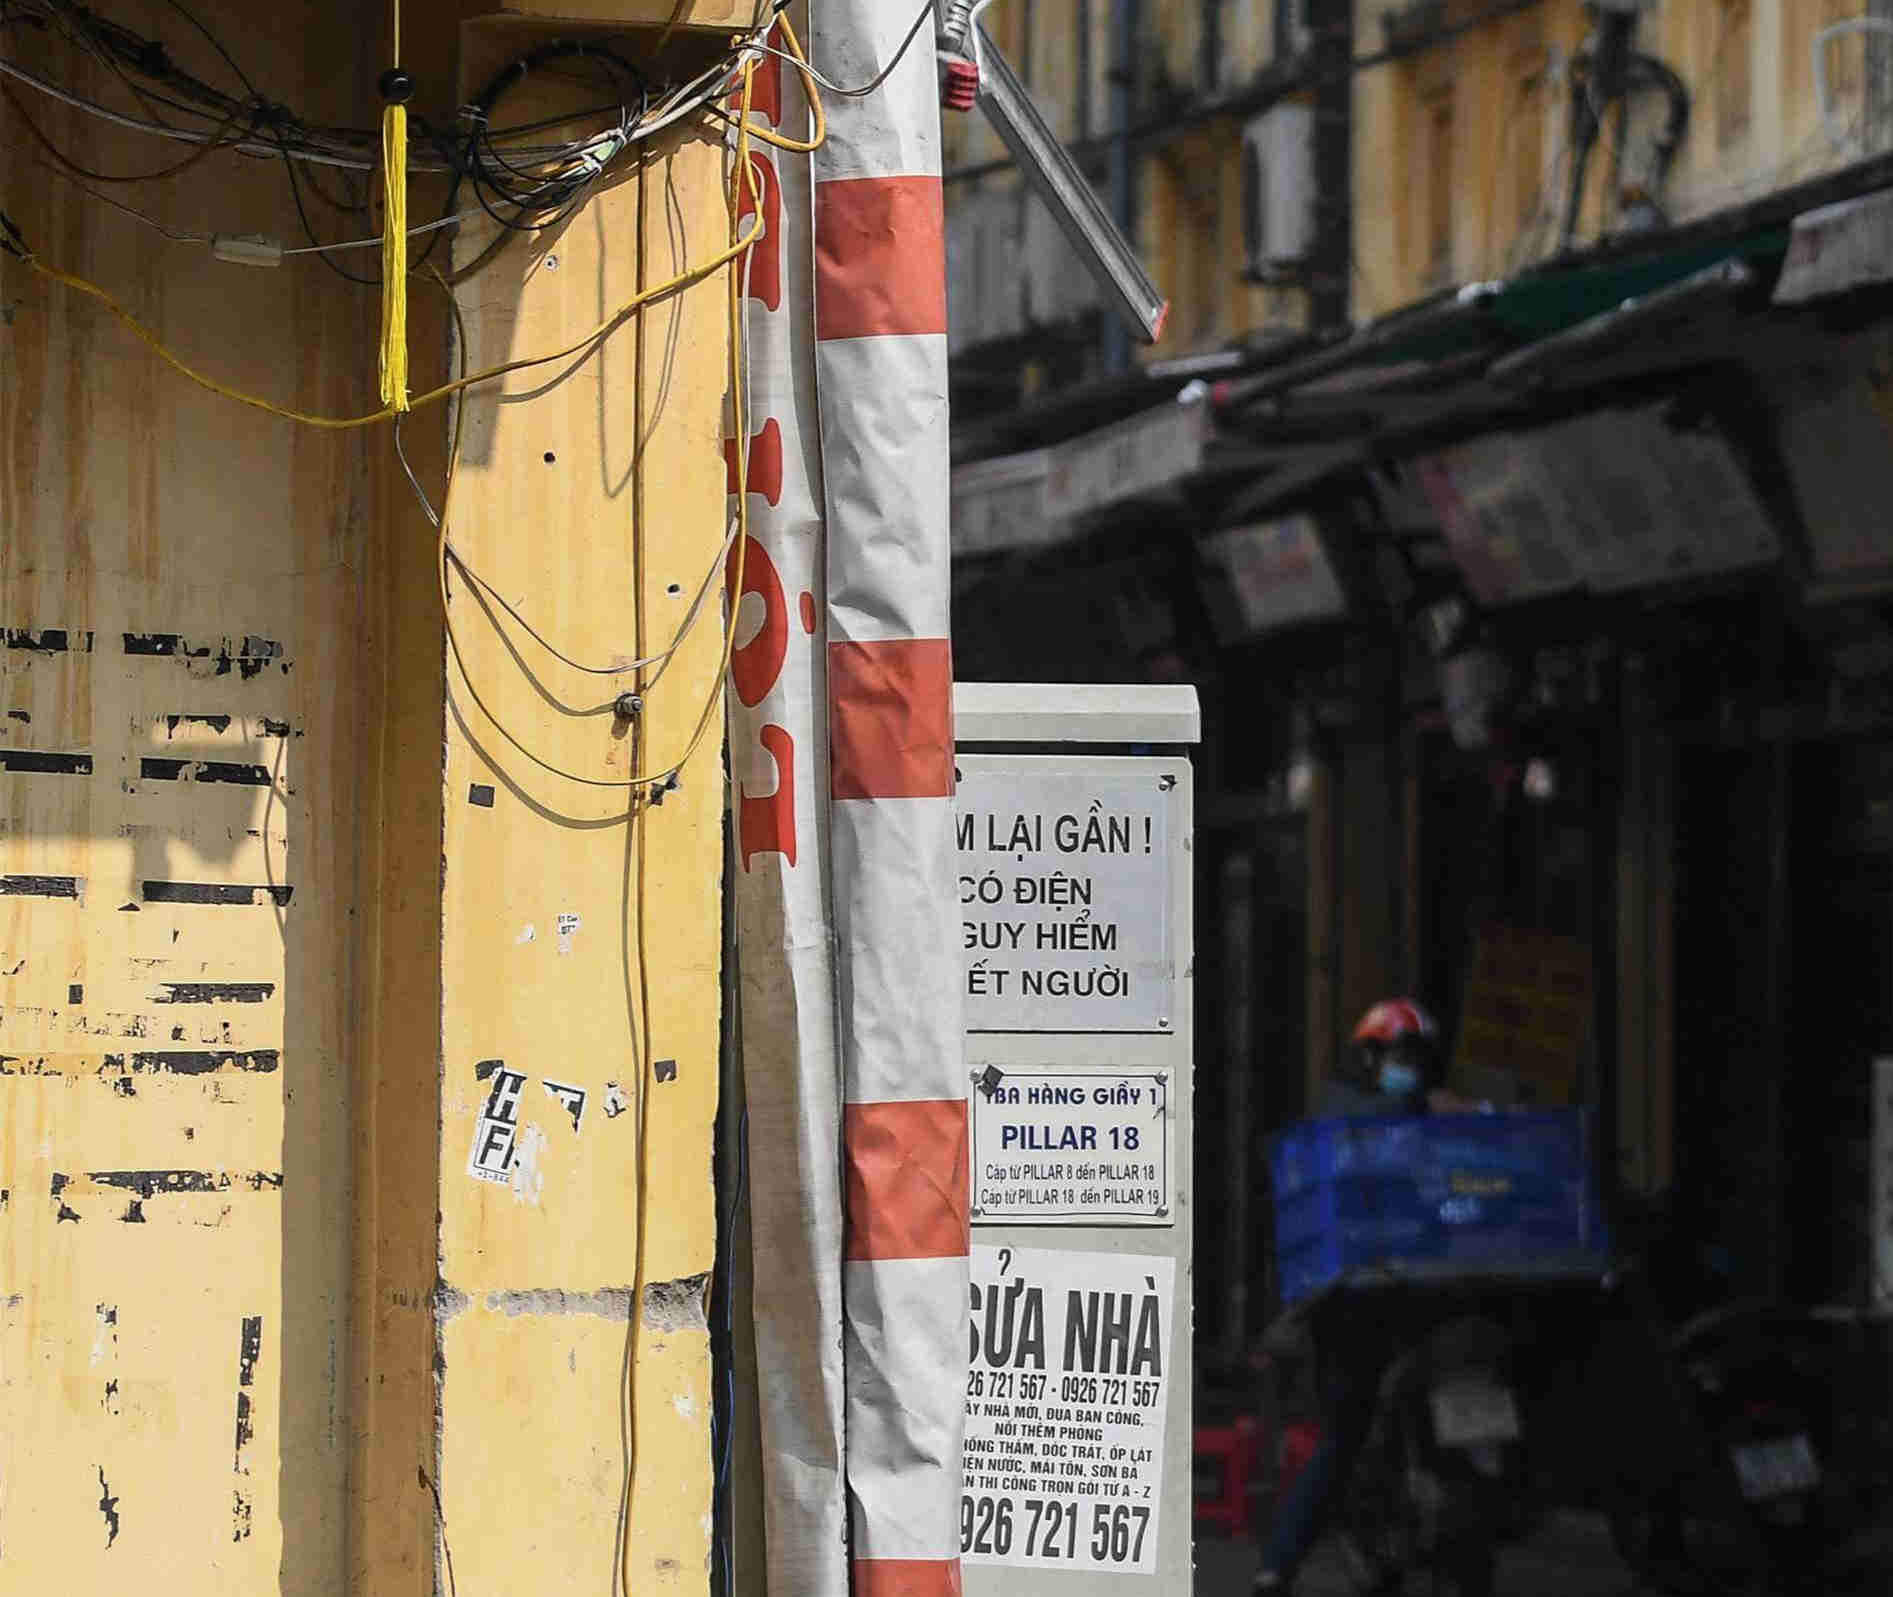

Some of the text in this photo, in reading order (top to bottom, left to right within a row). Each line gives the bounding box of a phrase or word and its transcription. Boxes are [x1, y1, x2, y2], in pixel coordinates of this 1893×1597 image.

[988, 813, 1042, 862] LẠI
[1054, 799, 1131, 853] GẦN
[959, 870, 1092, 912] CÓ ĐIỆN
[963, 908, 1117, 950] GUY HIỂM
[968, 958, 1129, 997] ẾT NGƯỜI
[985, 1087, 1021, 1105] BA
[1027, 1082, 1086, 1105] HÀNG
[1149, 1087, 1157, 1105] 1
[1001, 1125, 1140, 1150] PILLAR 18
[1023, 1164, 1064, 1180] PILLAR
[1099, 1164, 1139, 1180] PILLAR
[1143, 1164, 1155, 1181] 18
[1018, 1189, 1059, 1205] PILLAR
[1063, 1189, 1075, 1205] 18
[1103, 1189, 1144, 1205] PILLAR
[1148, 1189, 1160, 1206] 19
[1063, 1275, 1162, 1377] NHÀ
[967, 1370, 984, 1397] 26
[988, 1372, 1014, 1399] 721
[1019, 1373, 1047, 1401] 567
[1061, 1376, 1098, 1404] 0926
[1102, 1378, 1127, 1405] 721
[1132, 1380, 1160, 1408] 567
[979, 1476, 998, 1489] THI
[1121, 1485, 1130, 1497] A
[1143, 1486, 1151, 1498] Z
[960, 1495, 1151, 1563] 926 721 567
